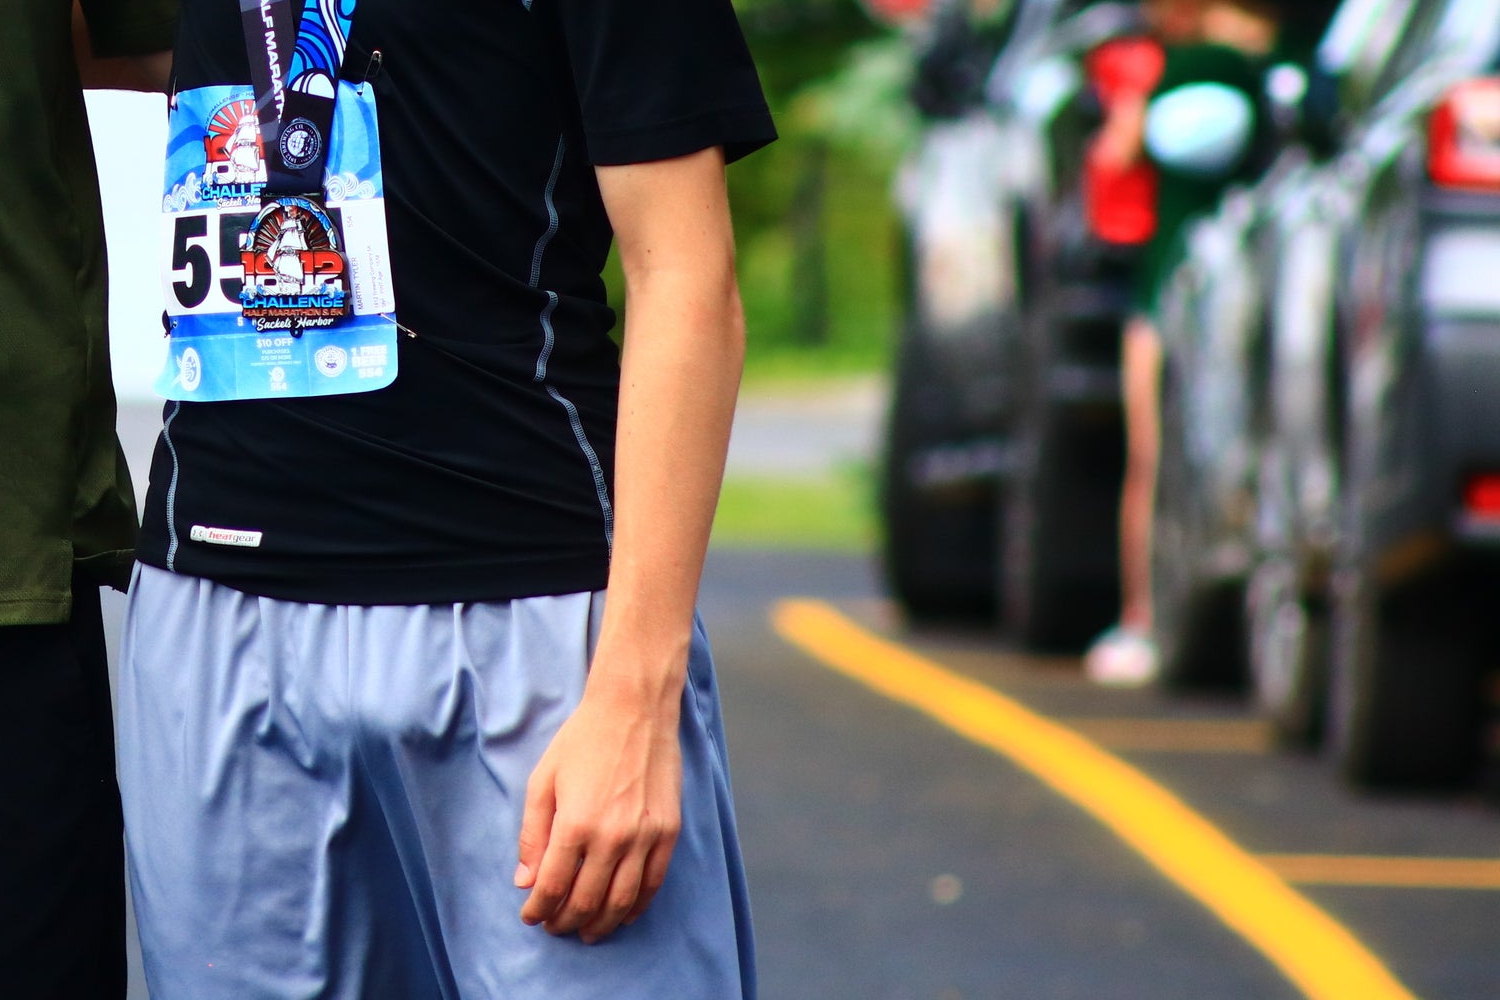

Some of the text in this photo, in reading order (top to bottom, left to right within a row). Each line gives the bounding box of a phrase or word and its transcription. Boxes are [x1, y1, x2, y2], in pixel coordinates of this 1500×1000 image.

[264, 31, 285, 123] MARAT
[202, 183, 267, 200] CHALLE
[243, 296, 344, 309] CHALLENGE
[243, 308, 268, 317] HALF
[268, 308, 321, 317] MARATHON
[330, 308, 344, 316] 5K
[294, 316, 334, 329] Harbor
